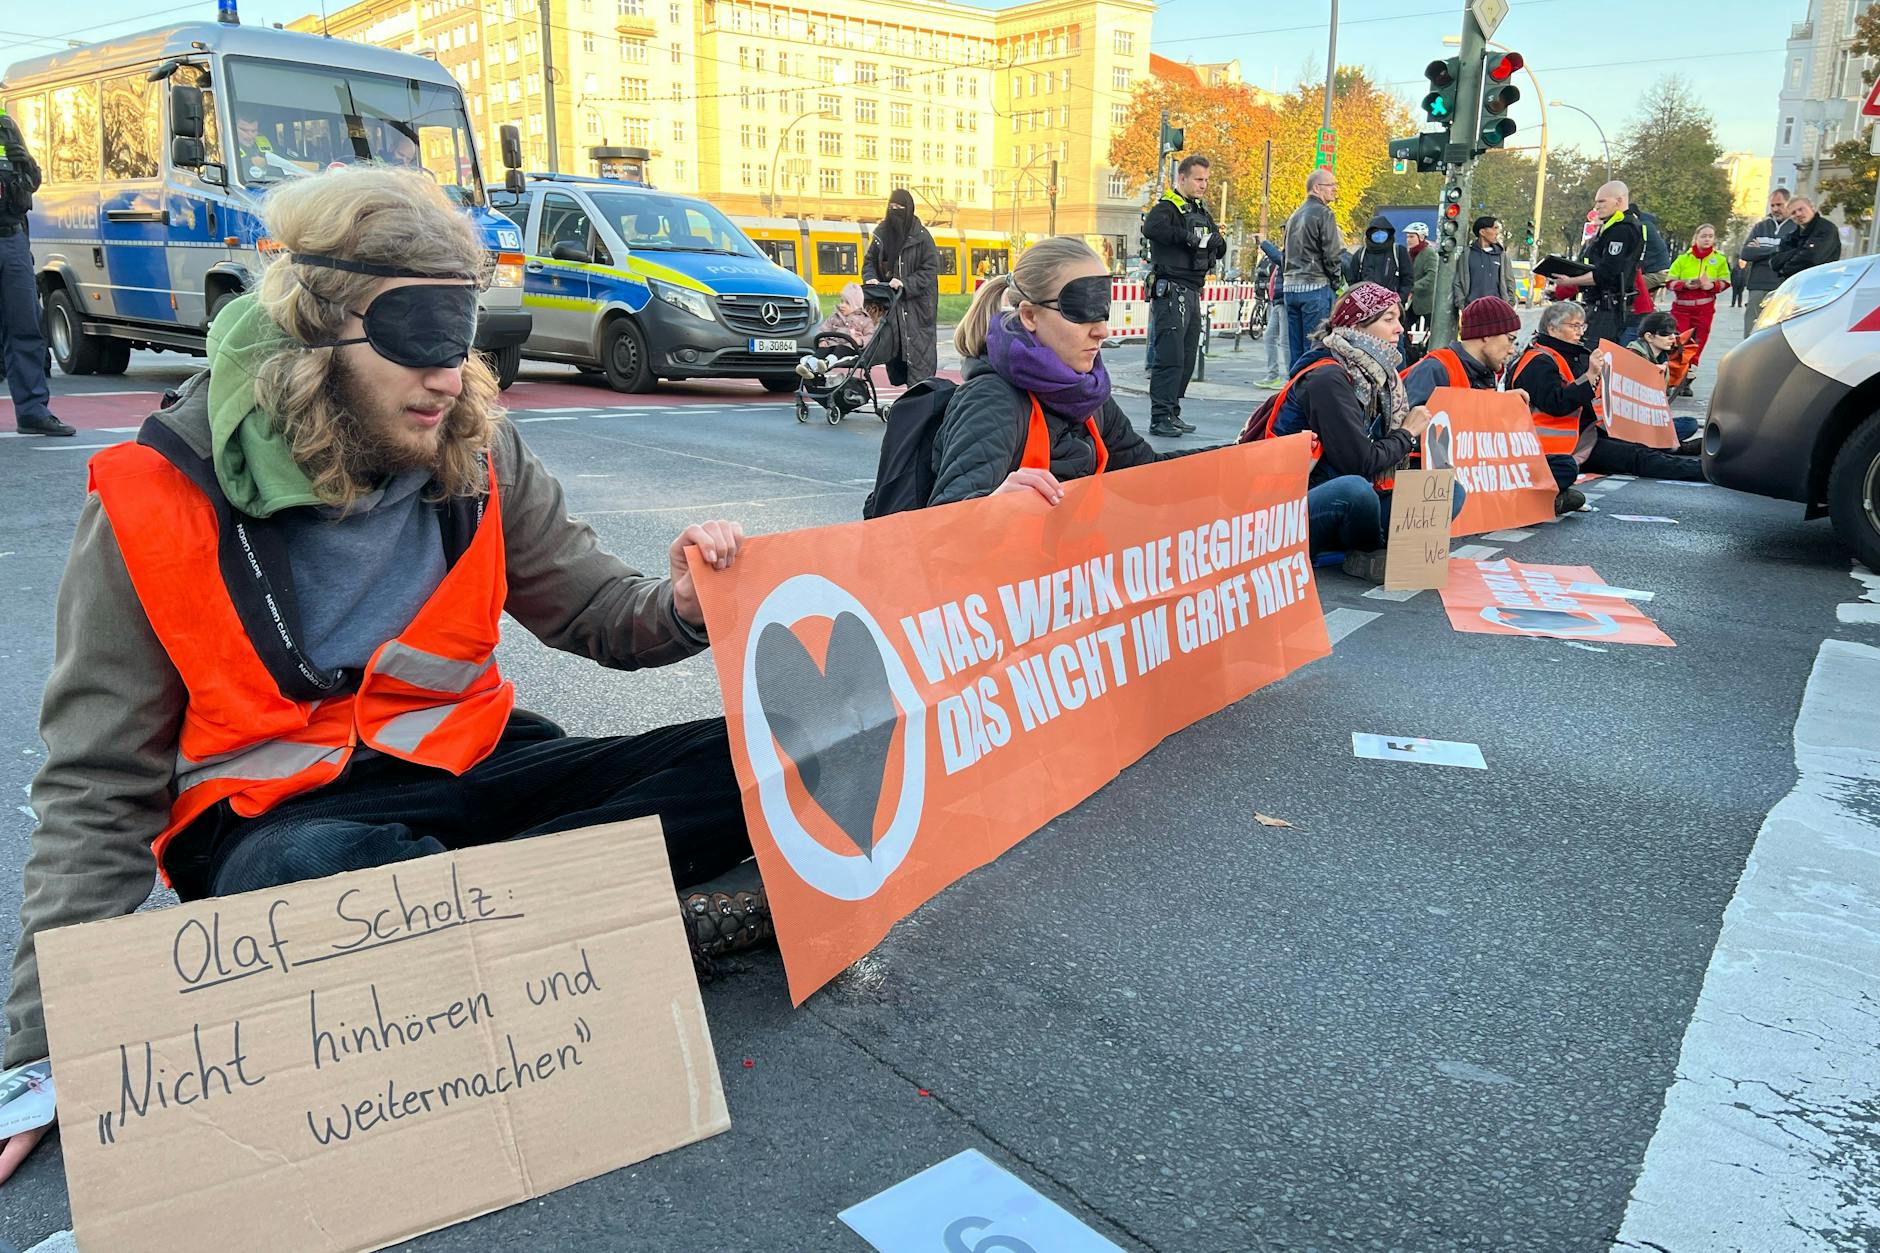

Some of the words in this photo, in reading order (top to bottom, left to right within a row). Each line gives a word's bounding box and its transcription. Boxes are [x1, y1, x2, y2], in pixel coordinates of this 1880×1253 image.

[57, 203, 98, 230] POLIZEI
[501, 232, 518, 247] 13
[759, 341, 765, 351] B
[769, 341, 793, 351] 30864
[1456, 431, 1474, 459] 100
[1499, 463, 1534, 491] ALLE
[236, 523, 251, 552] NORD
[247, 552, 263, 580] CAPE
[265, 593, 281, 623] NORD
[277, 622, 293, 650] CAPE
[900, 593, 1004, 685] WAS,
[1122, 536, 1175, 604] DIE
[937, 675, 1012, 776] DAS
[1005, 623, 1128, 732] NICHT
[1130, 605, 1171, 676] IM
[173, 899, 290, 985] Olaf
[310, 983, 495, 1070] hinhören
[525, 948, 601, 1006] und
